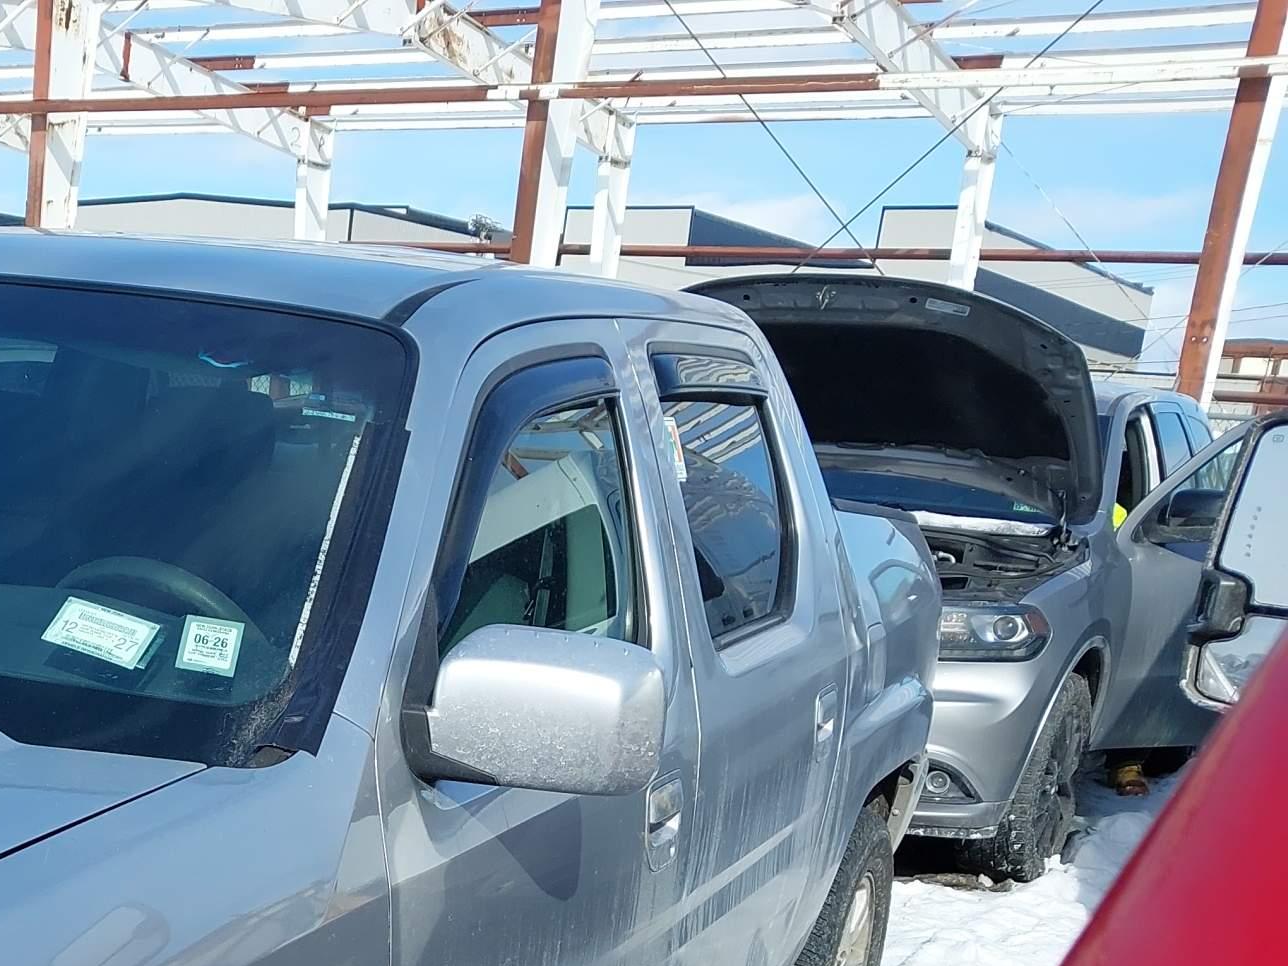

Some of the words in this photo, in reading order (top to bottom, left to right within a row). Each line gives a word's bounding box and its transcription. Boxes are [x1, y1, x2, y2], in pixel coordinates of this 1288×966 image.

[60, 619, 79, 634] 12
[113, 637, 139, 653] 27
[194, 634, 210, 645] 06
[213, 636, 229, 649] 26
